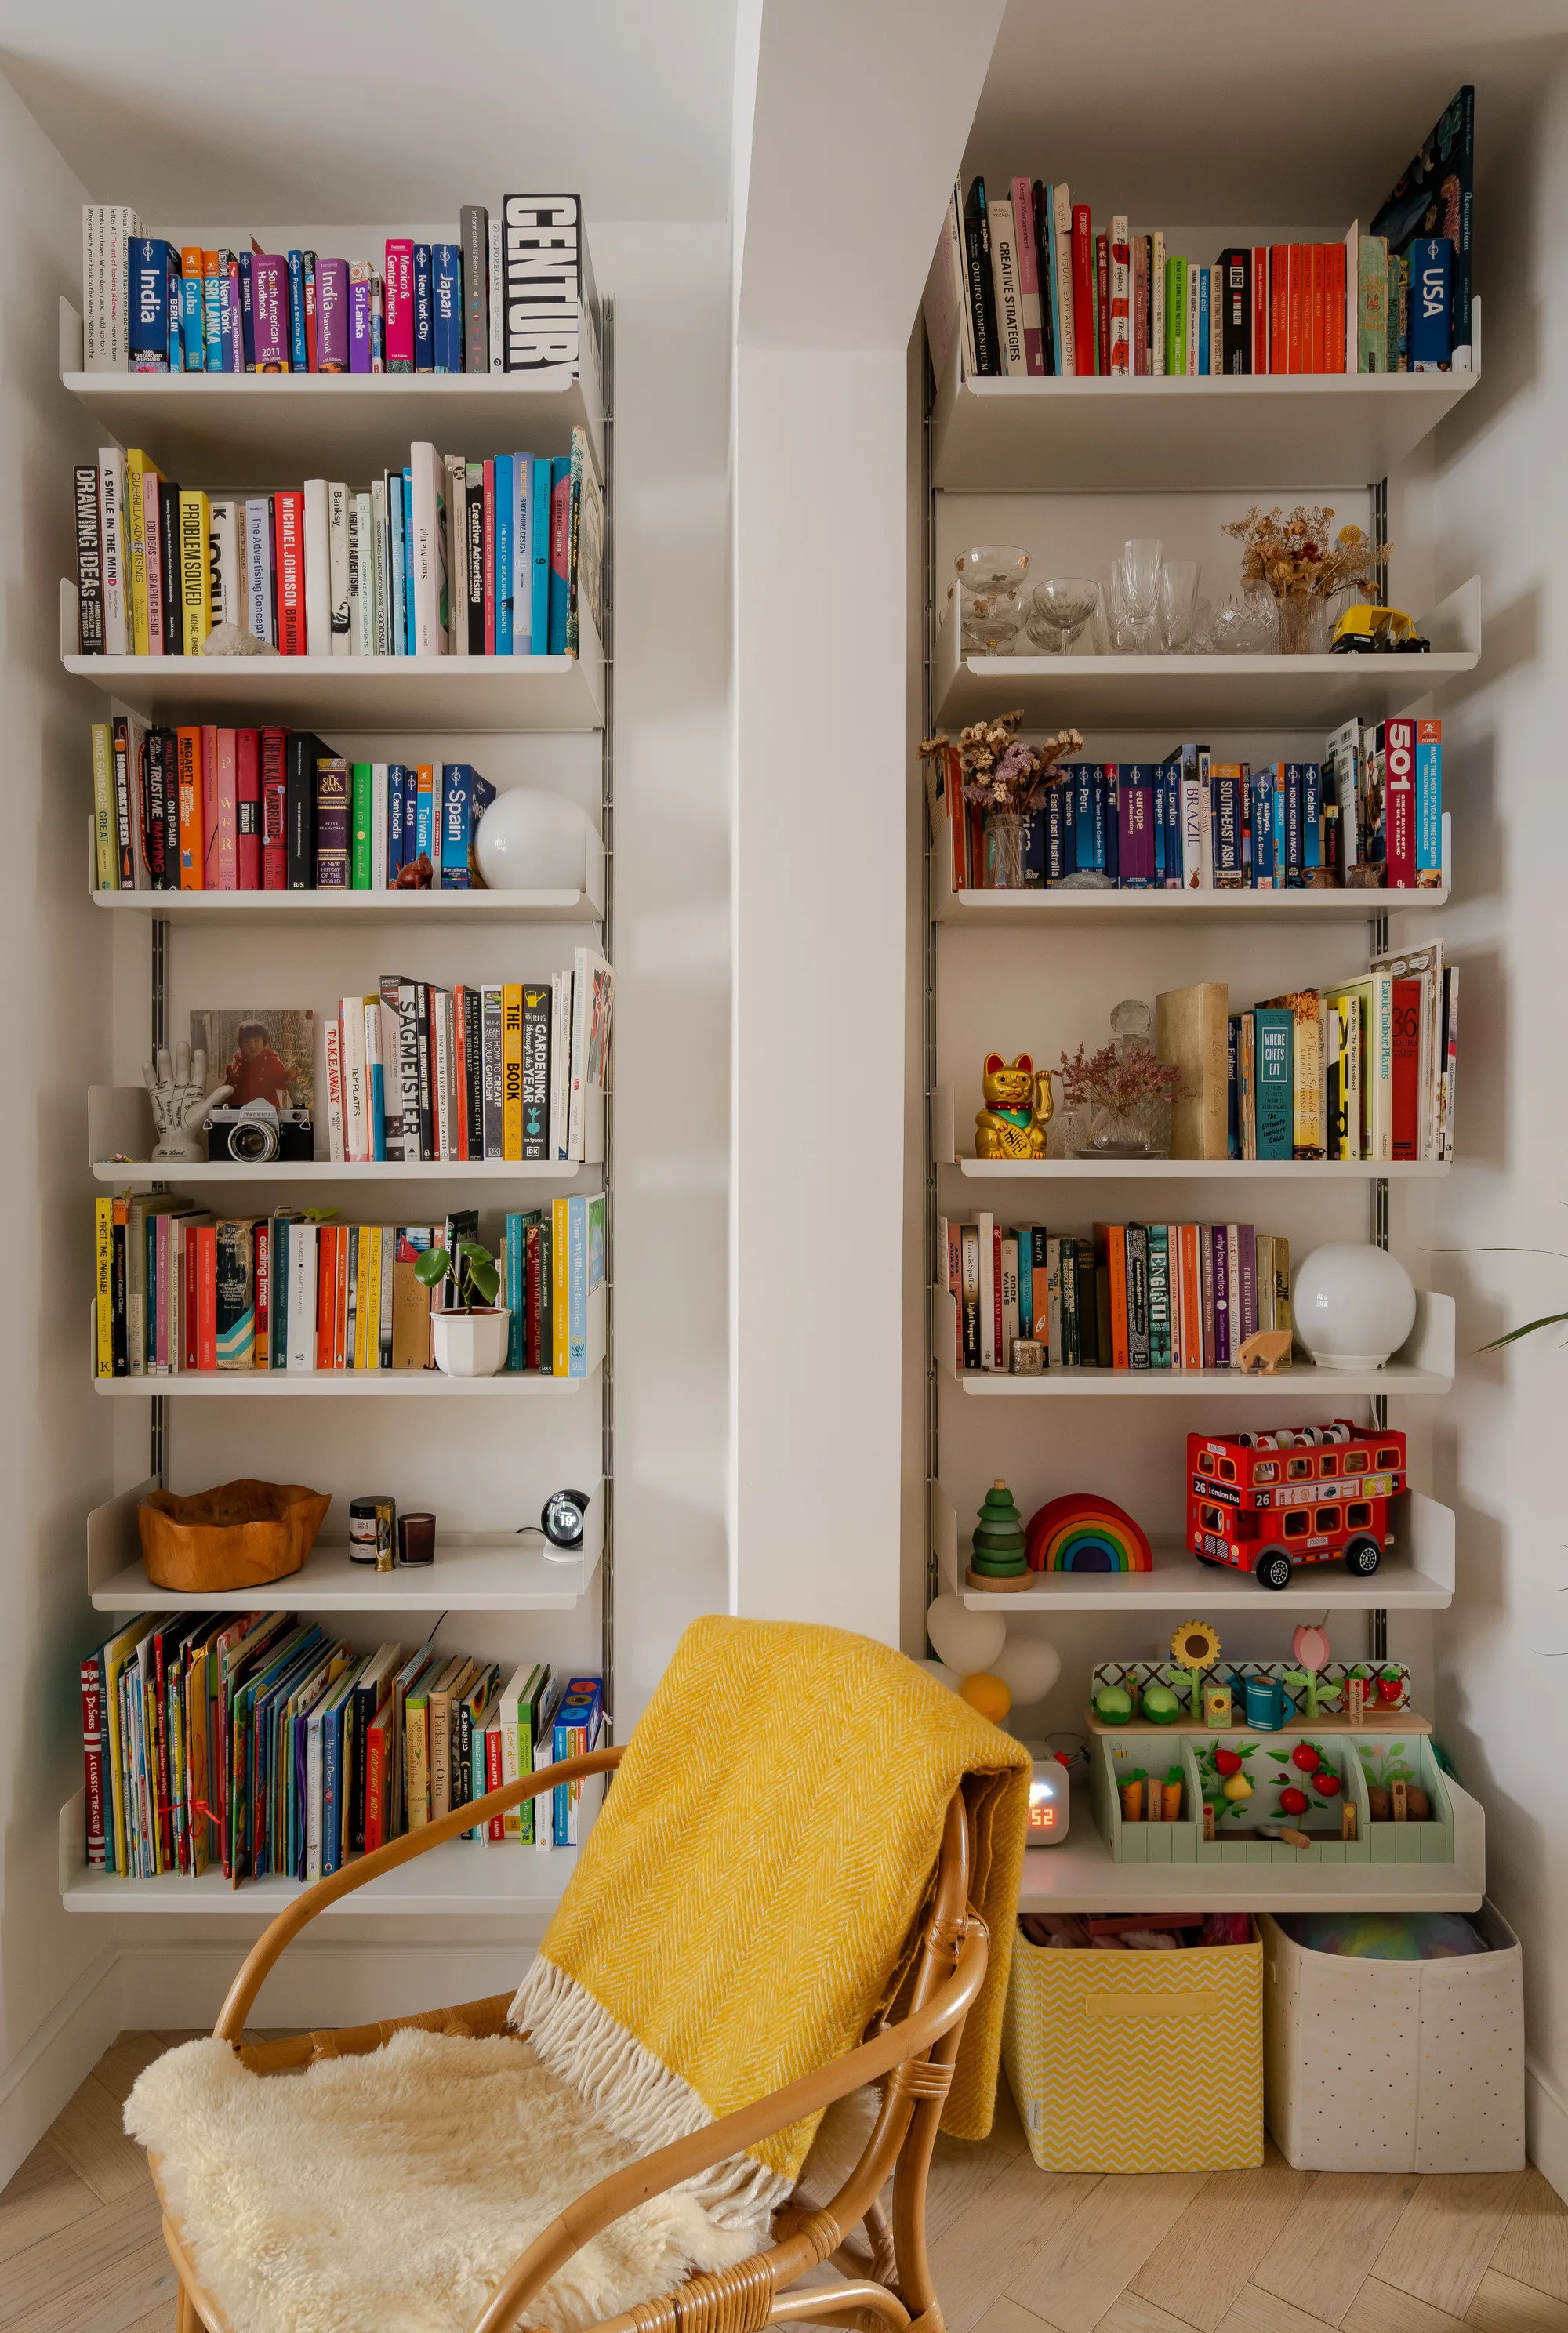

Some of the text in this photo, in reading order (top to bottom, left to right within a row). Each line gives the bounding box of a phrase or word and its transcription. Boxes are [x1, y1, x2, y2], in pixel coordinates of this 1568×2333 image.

[1464, 192, 1472, 251] Oceanarium
[322, 272, 336, 311] India
[387, 255, 398, 325] Central America
[400, 255, 409, 290] Mexico
[1230, 267, 1243, 288] LOGO
[1422, 268, 1444, 317] USA
[140, 270, 160, 323] India
[186, 282, 195, 315] Cuba
[205, 280, 216, 344] SRI LANKA
[268, 270, 278, 343] South American
[355, 287, 365, 339] Sri Lanka
[418, 274, 429, 340] New York City
[440, 273, 453, 318] Japan
[971, 262, 988, 371] OULIPO COMPENDIUM
[1000, 241, 1020, 361] CREATIVE STRATEGIES
[221, 307, 230, 334] York
[105, 481, 114, 513] SMILE
[332, 491, 342, 527] Banksy
[76, 470, 99, 597] DRAWING IDEAS
[106, 518, 114, 529] IN
[132, 472, 143, 582] GUERRILLA ADVERTISING
[350, 539, 357, 549] ON
[419, 528, 428, 542] Up!
[107, 557, 117, 586] MIND
[183, 504, 201, 606] PROBLEM SOLVED
[420, 546, 428, 556] Me
[471, 502, 483, 603] Creative Advertising
[252, 517, 266, 634] The Advertising Concept
[282, 498, 296, 655] MICHAEL JOHNSON BRANDIN
[184, 738, 193, 786] HEGARTY
[1390, 725, 1410, 790] 501
[95, 731, 108, 844] MAKE GARBAGE GREAT
[117, 754, 129, 846] HOME BREW BEER
[1080, 789, 1088, 813] Peru
[1307, 788, 1316, 822] Iceland
[393, 793, 401, 840] Cambodia
[419, 808, 429, 847] Taiwan
[445, 790, 466, 841] Spain
[1051, 813, 1059, 836] Coast
[1186, 788, 1200, 847] BRAZIL
[1221, 781, 1235, 868] SOUTH-EAST ASIA
[506, 1004, 520, 1030] THE
[1381, 981, 1391, 1079] Exotic Indoor Plants
[1392, 1008, 1417, 1036] 36
[1265, 1034, 1285, 1046] WHERE
[1265, 1049, 1284, 1061] CHEFS
[327, 1029, 339, 1104] TAKEAWAY
[400, 1000, 419, 1136] SAGMEISTER
[507, 1063, 520, 1100] BOOK
[535, 1024, 546, 1104] GARDENING
[1269, 1064, 1279, 1076] EAT
[523, 1071, 535, 1103] YEAR
[260, 1236, 268, 1277] exciting
[574, 1240, 583, 1290] Wellbeing
[967, 1302, 976, 1350] Light Perpetual
[1195, 1480, 1206, 1493] 26
[1209, 1489, 1240, 1503] London Bus
[1257, 1493, 1269, 1506] 26
[86, 1696, 98, 1729] Dr.Seuss
[368, 1748, 379, 1788] GOODNIGHT
[434, 1712, 445, 1798] Tarka the Otter
[91, 1794, 100, 1834] TREASURY
[1031, 1809, 1053, 1826] 52
